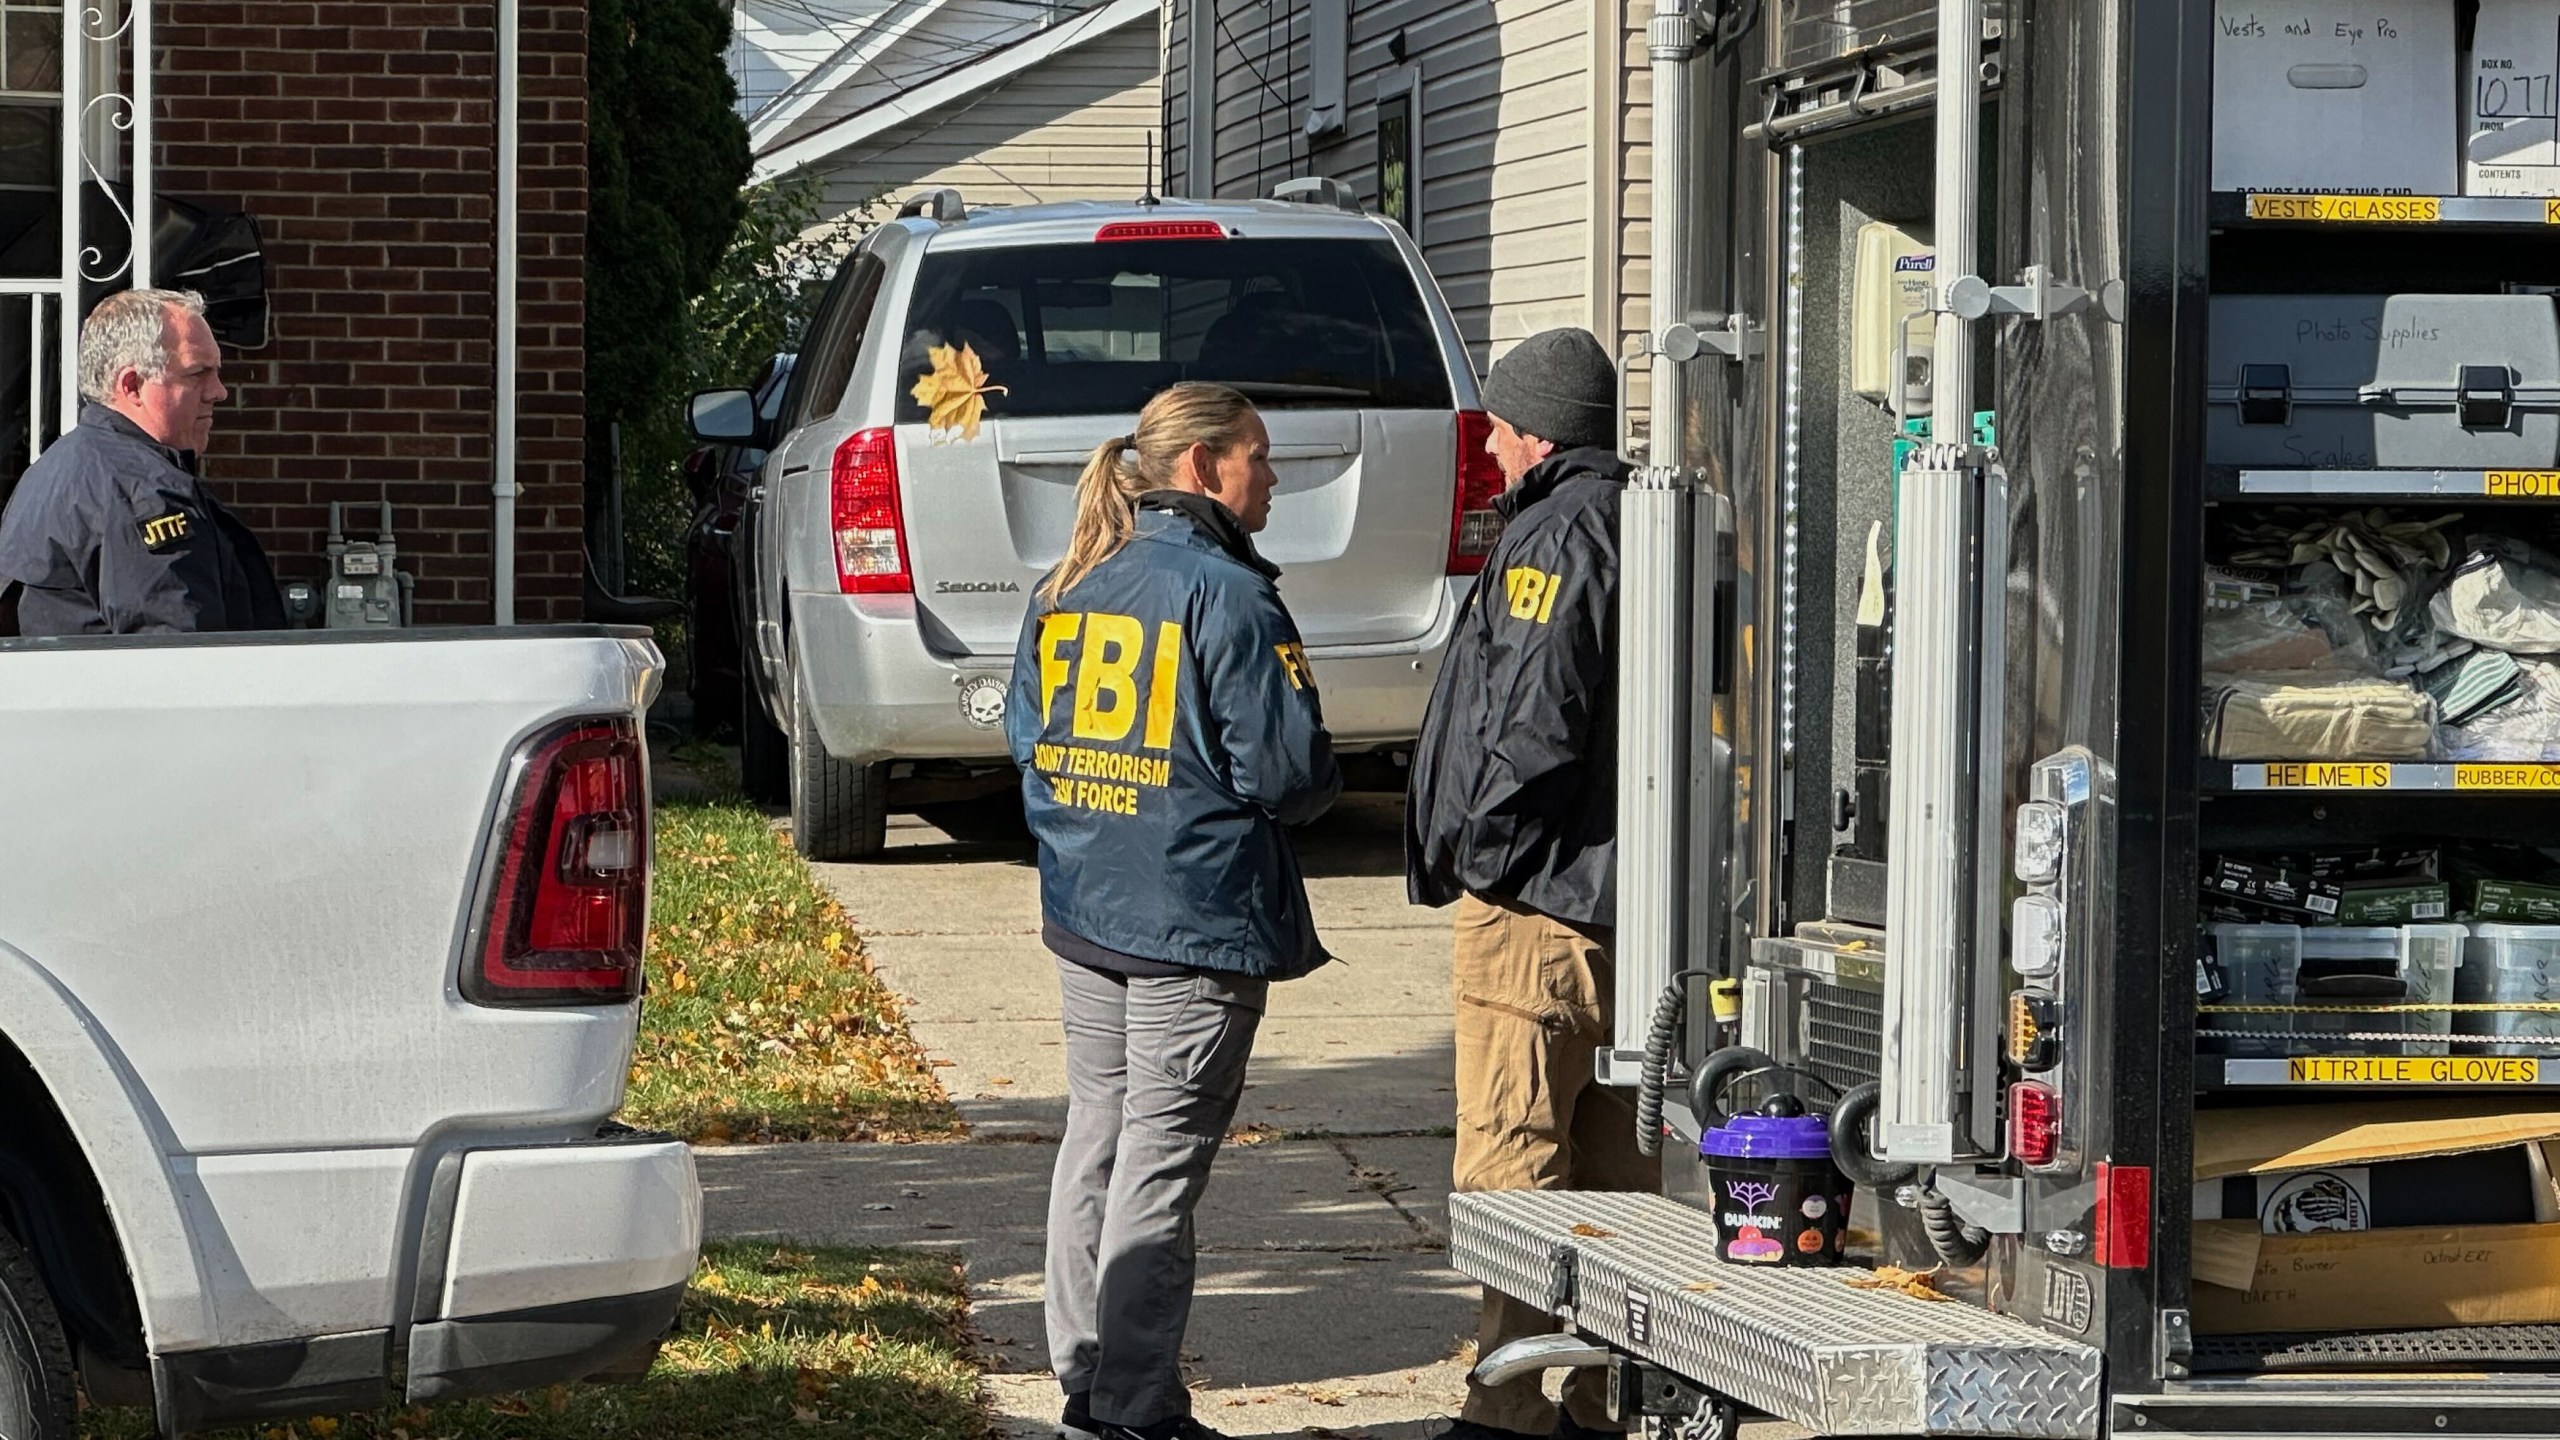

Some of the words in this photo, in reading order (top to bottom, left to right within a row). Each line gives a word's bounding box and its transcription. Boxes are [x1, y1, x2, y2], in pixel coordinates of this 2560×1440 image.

[2219, 13, 2266, 38] Vests
[2284, 18, 2311, 36] and
[2334, 22, 2364, 46] Eye
[2376, 18, 2397, 39] Pro
[2481, 59, 2498, 69] BOX
[2500, 60, 2516, 70] NO.
[2477, 75, 2551, 116] 1077
[2478, 170, 2522, 179] CONTENTS
[2252, 198, 2437, 220] VESTS/GLASSES
[2296, 318, 2350, 343] Photo
[2360, 316, 2441, 348] Supplies
[2284, 434, 2368, 466] Scales
[2488, 473, 2560, 496] PHOT
[143, 512, 187, 545] JTTF
[1039, 612, 1182, 749] FBI
[1066, 747, 1170, 787] TERRORISM
[2267, 765, 2388, 787] HELMETS
[1076, 780, 1138, 816] FORCE
[2290, 1061, 2411, 1081] NITRILE
[2430, 1061, 2535, 1081] GLOVES
